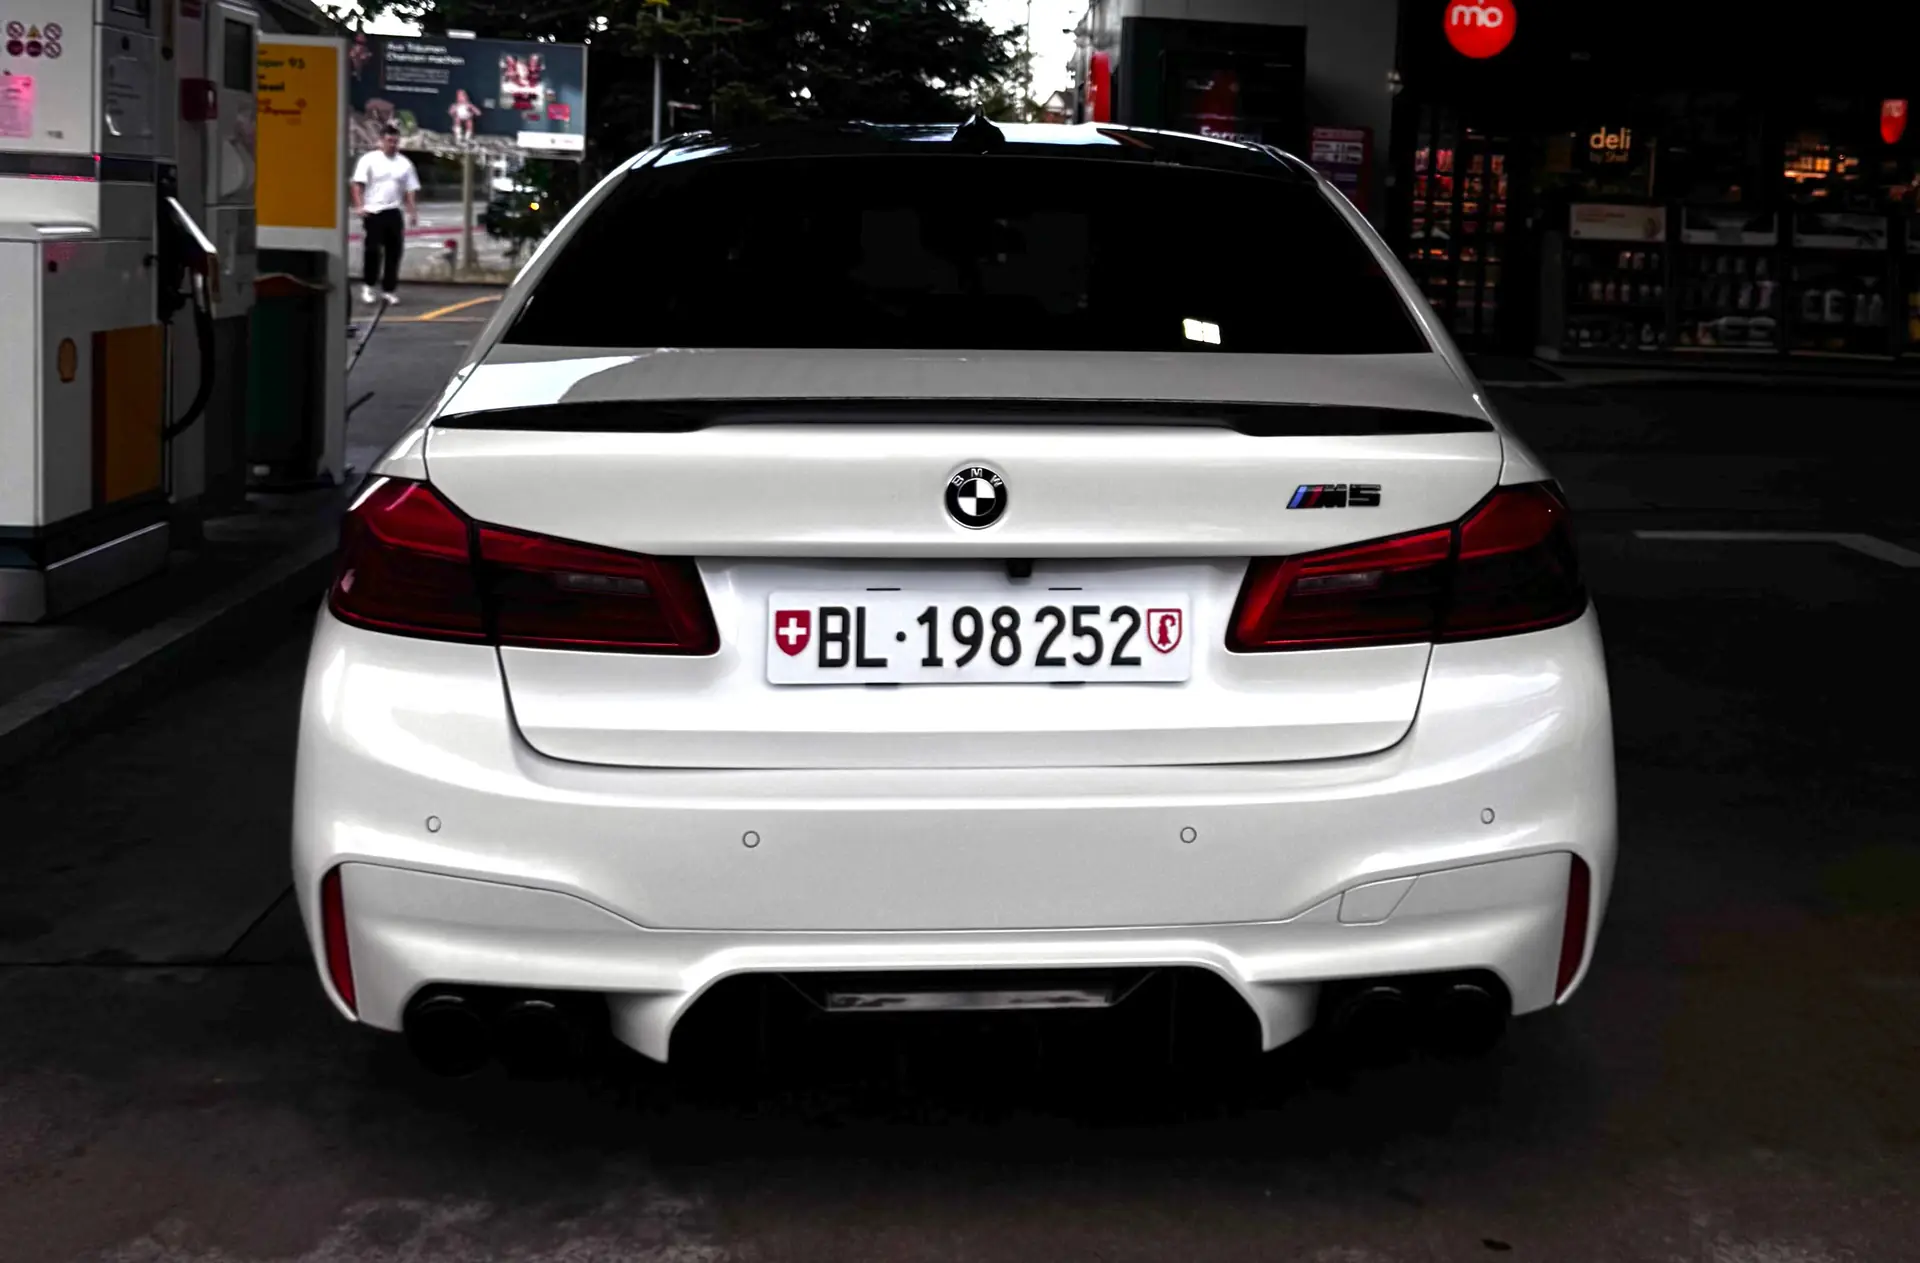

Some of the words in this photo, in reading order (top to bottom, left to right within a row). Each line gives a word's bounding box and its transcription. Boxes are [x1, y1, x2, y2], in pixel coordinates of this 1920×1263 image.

[1590, 126, 1631, 150] deli
[951, 467, 1003, 488] BMW
[1300, 484, 1381, 508] M5
